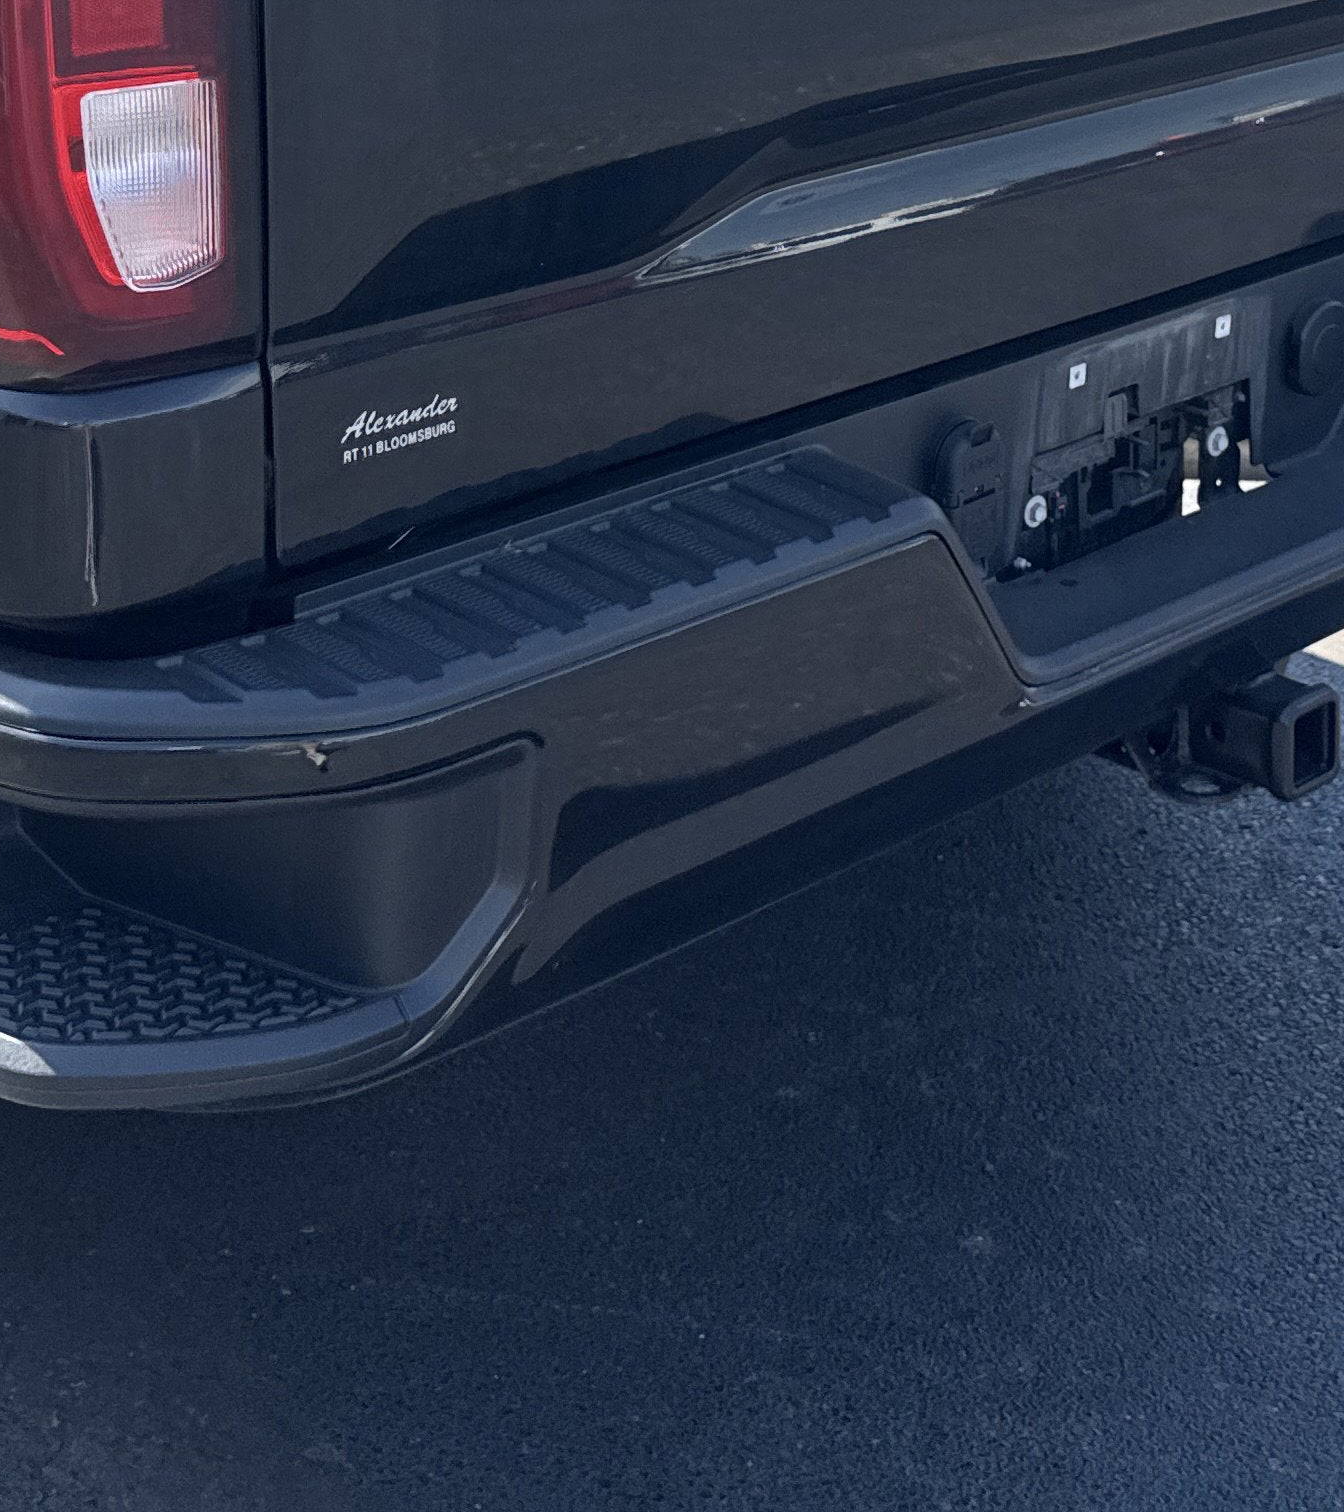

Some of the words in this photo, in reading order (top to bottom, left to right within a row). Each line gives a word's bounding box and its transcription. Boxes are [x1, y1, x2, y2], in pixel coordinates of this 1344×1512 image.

[340, 393, 459, 445] Alexander
[342, 447, 359, 465] RT
[376, 419, 457, 455] BLOOMSBURG
